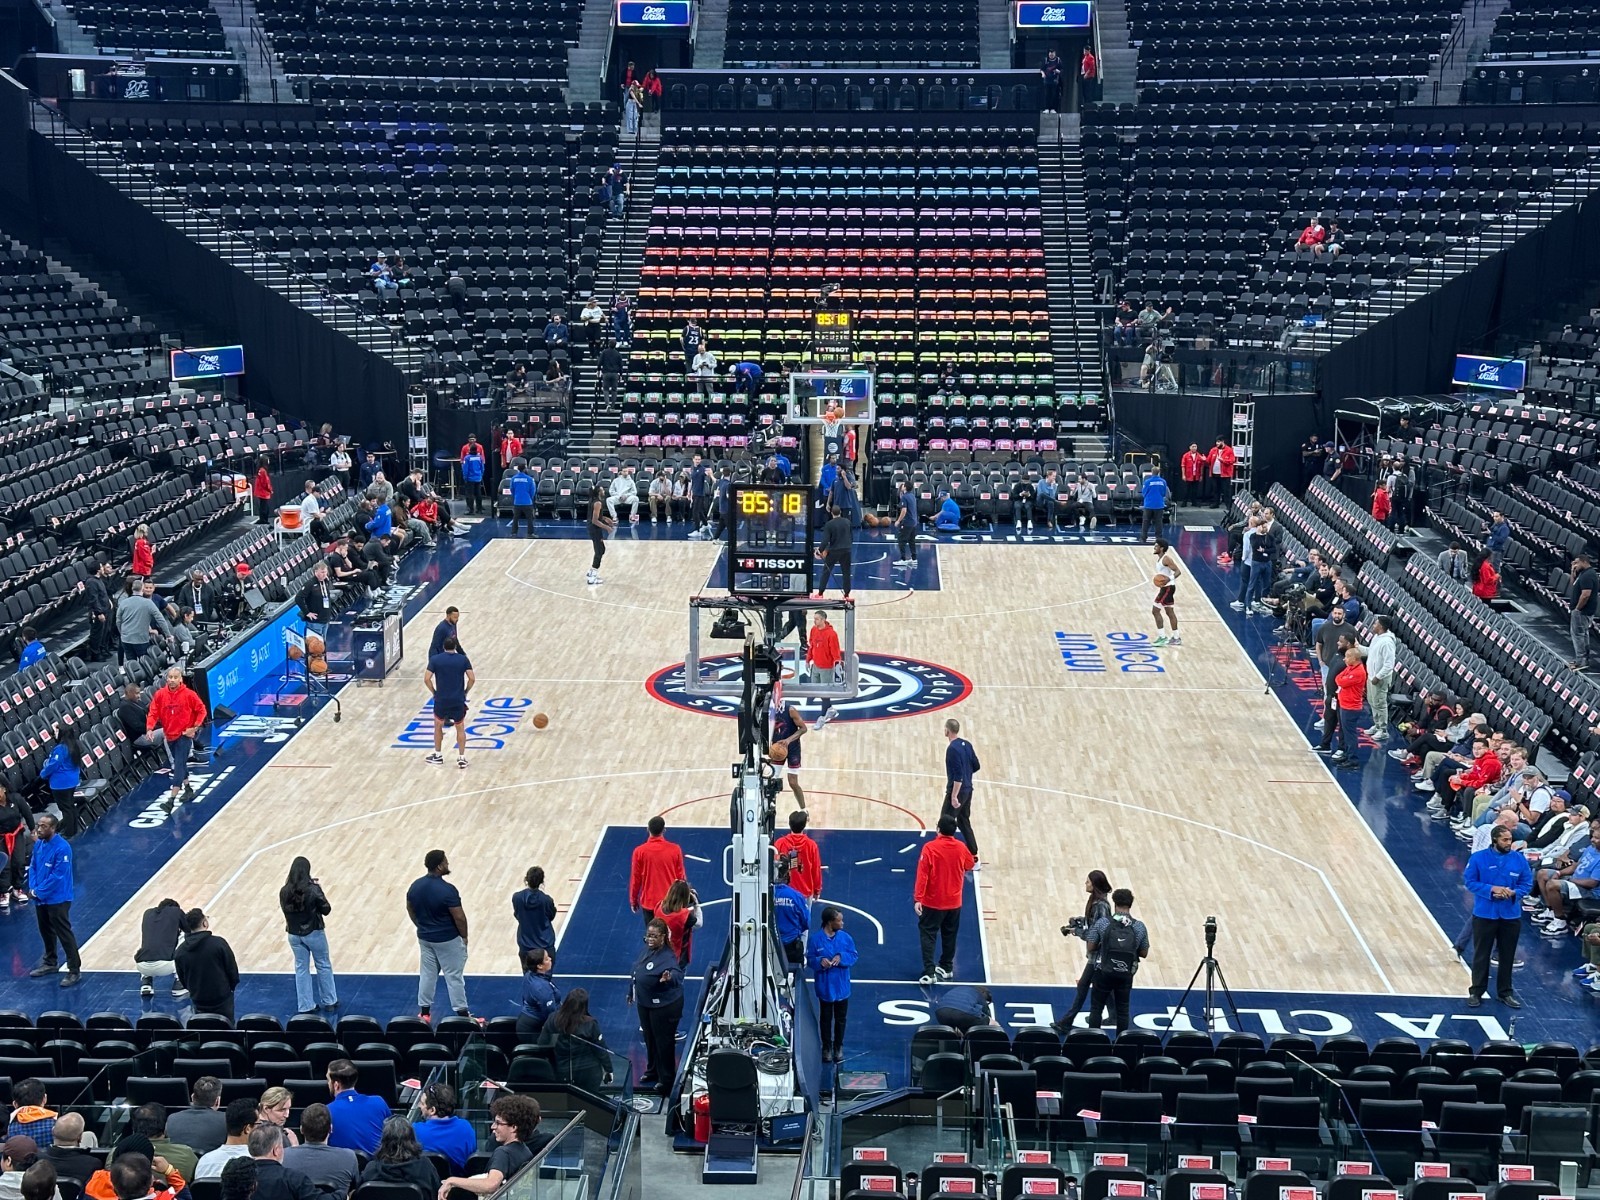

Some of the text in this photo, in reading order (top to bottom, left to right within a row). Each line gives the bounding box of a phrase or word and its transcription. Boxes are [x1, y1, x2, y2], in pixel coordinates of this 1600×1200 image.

[644, 6, 665, 14] Open
[1044, 7, 1065, 15] Open
[817, 313, 848, 325] 85:18
[688, 335, 699, 345] 23
[742, 493, 801, 514] 85:18
[755, 559, 805, 569] TISSOT
[259, 642, 270, 663] AT&T
[1055, 631, 1107, 672] INTUIT
[226, 667, 239, 690] AT&T
[886, 660, 954, 713] CLIPPERS
[877, 1000, 1354, 1036] CLIPPES
[1375, 1012, 1510, 1041] LA
